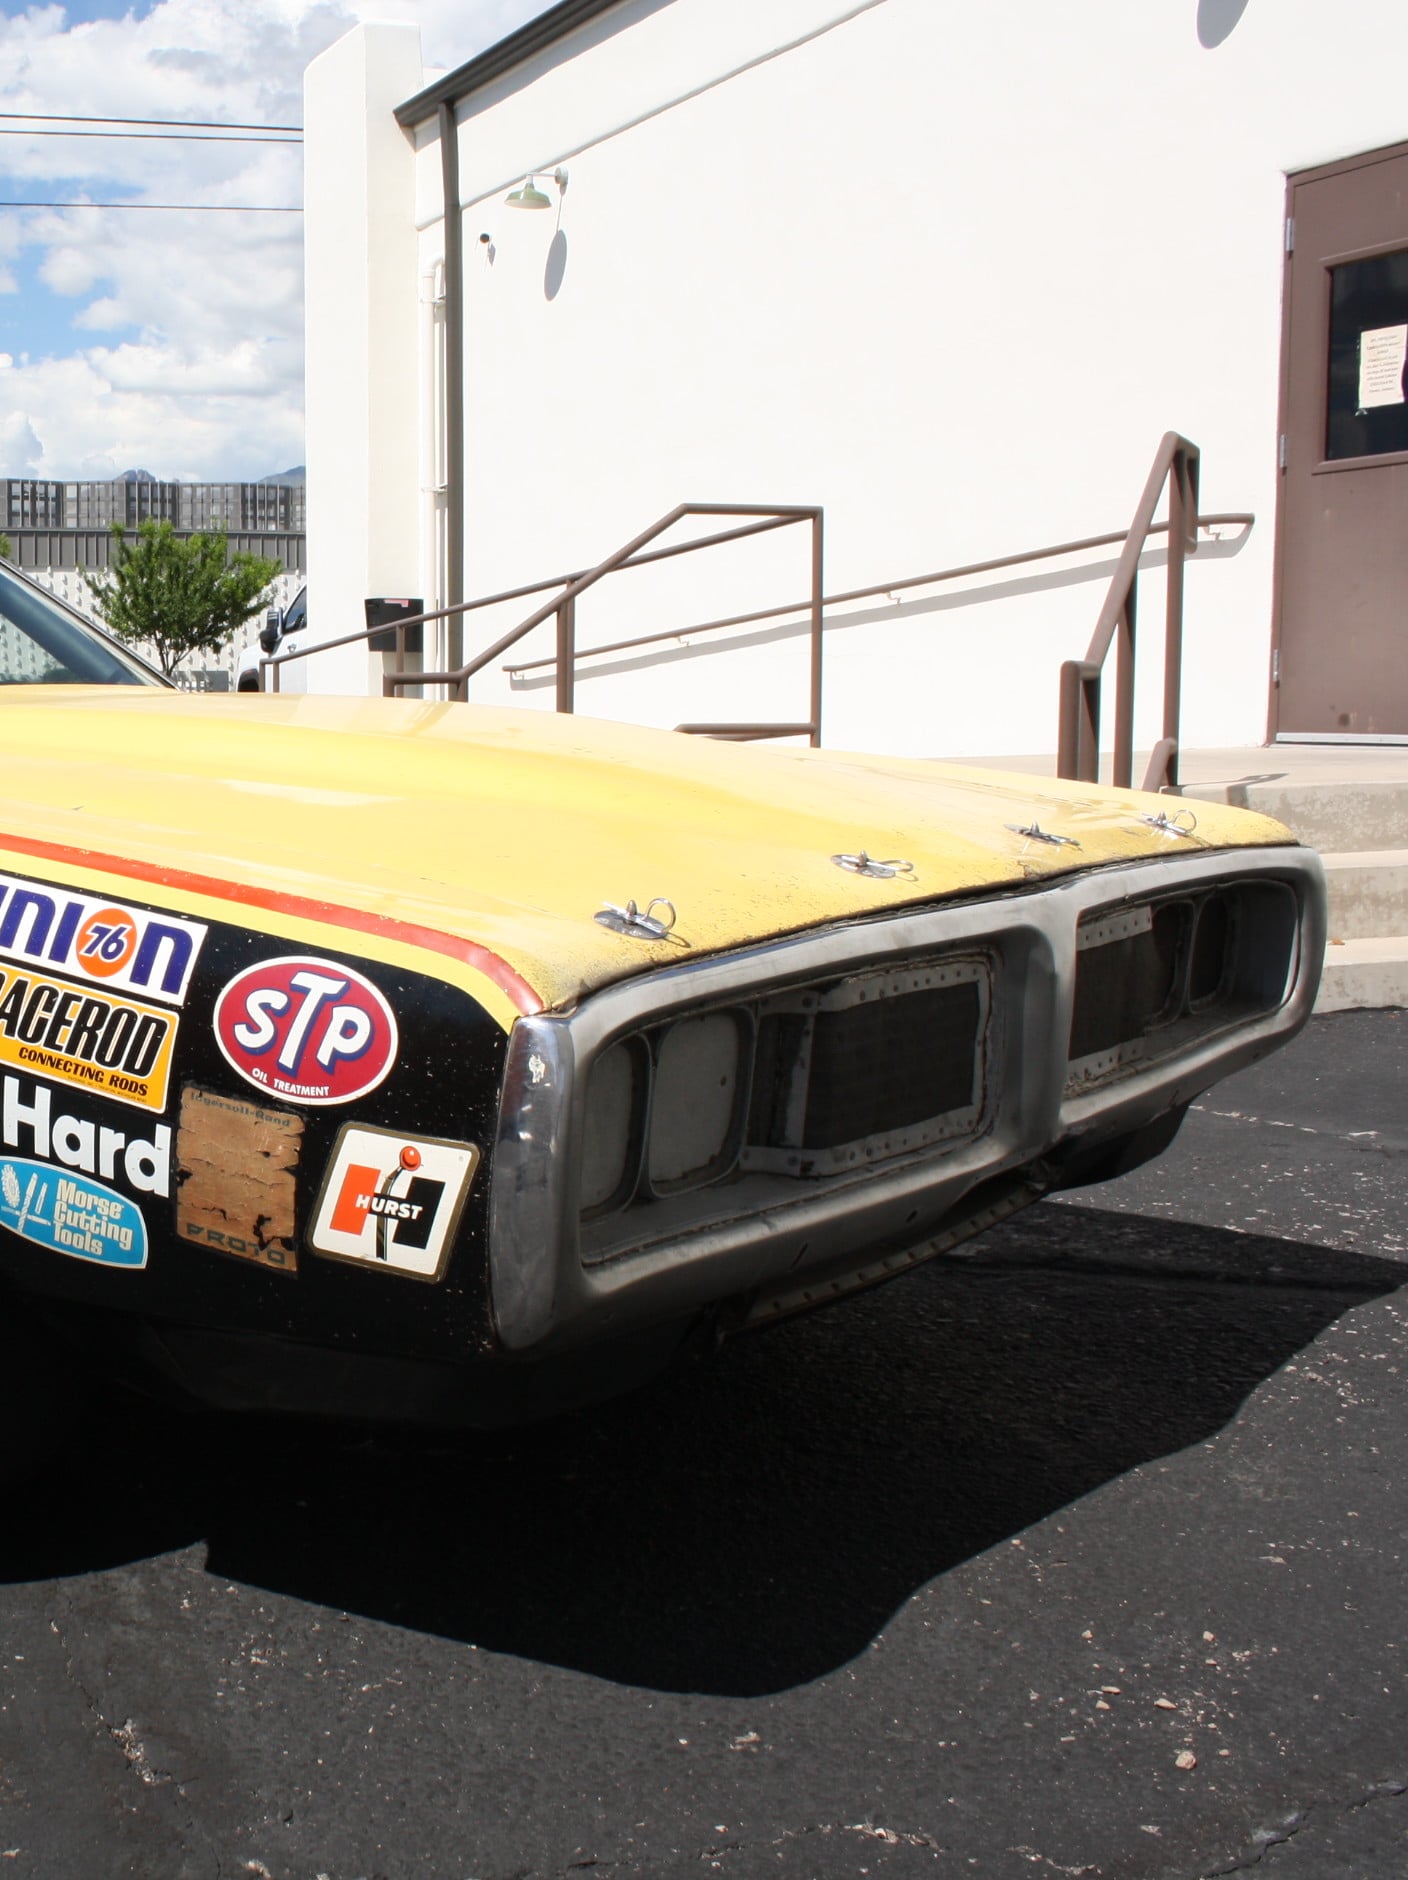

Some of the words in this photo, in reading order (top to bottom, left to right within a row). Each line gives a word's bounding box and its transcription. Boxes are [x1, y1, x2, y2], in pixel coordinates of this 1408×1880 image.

[80, 922, 133, 961] 76
[234, 971, 372, 1071] STP
[18, 1046, 104, 1083] CONNECTING
[108, 1073, 149, 1096] RODS
[252, 1067, 269, 1084] OIL
[273, 1077, 330, 1097] TREATMENT
[55, 1178, 123, 1218] Morse
[355, 1194, 423, 1220] HURST
[53, 1221, 103, 1256] Tools
[54, 1200, 134, 1251] Cutting
